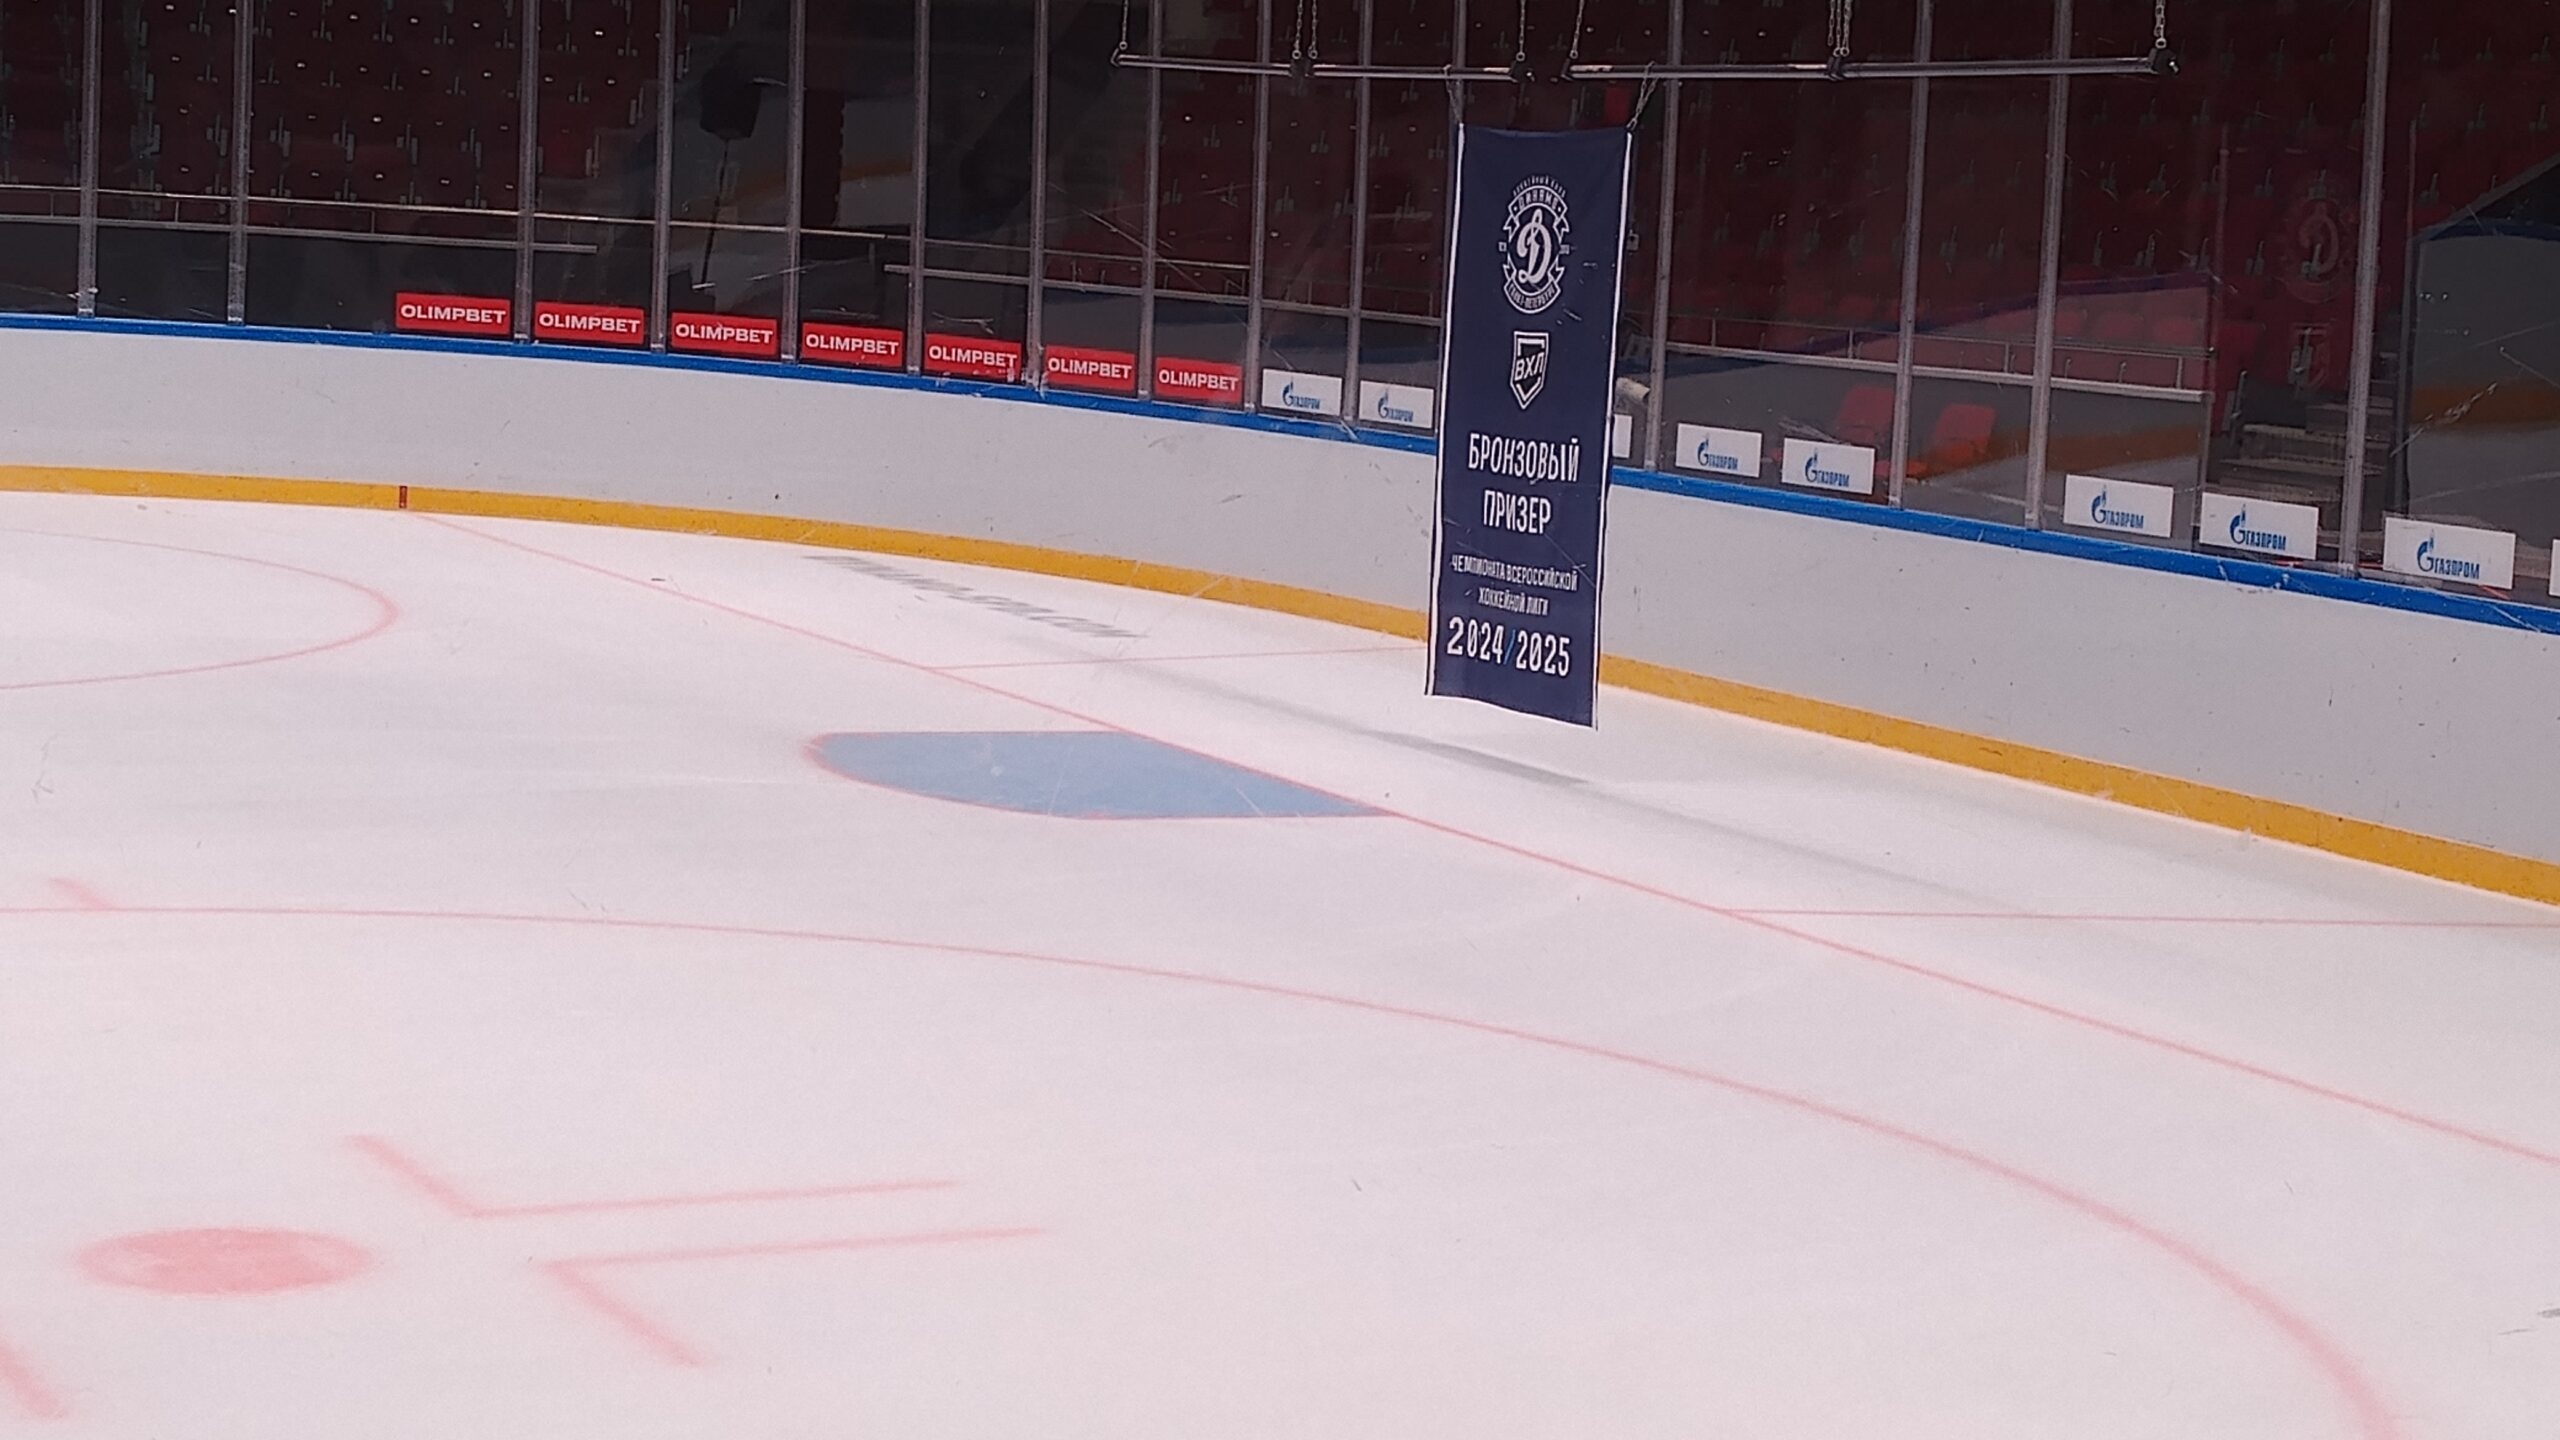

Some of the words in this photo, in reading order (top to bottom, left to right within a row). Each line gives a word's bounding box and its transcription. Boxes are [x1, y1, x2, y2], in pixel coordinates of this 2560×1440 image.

[400, 304, 507, 325] OLIMPBET
[538, 312, 641, 334] OLIMPBET
[674, 322, 774, 345] OLIMPBET
[805, 333, 900, 356] OLIMPBET
[928, 345, 1018, 369] OLIMPBET
[1047, 356, 1132, 380] OLIMPBET
[1514, 351, 1545, 381] ВХЛ
[1158, 368, 1239, 392] OLIMPBET
[1467, 432, 1580, 482] БРОНЗОВЫЙ
[1483, 489, 1551, 534] ПРИЗЕР
[1451, 554, 1505, 580] ЧЕМПИОНАТА
[1506, 564, 1578, 591] ВСЕРОССИЙСКОЙ
[1478, 587, 1525, 613] ХОККЕЙНОЙ
[1526, 596, 1549, 616] ЛИГИ
[1447, 616, 1570, 677] 2024/2025
